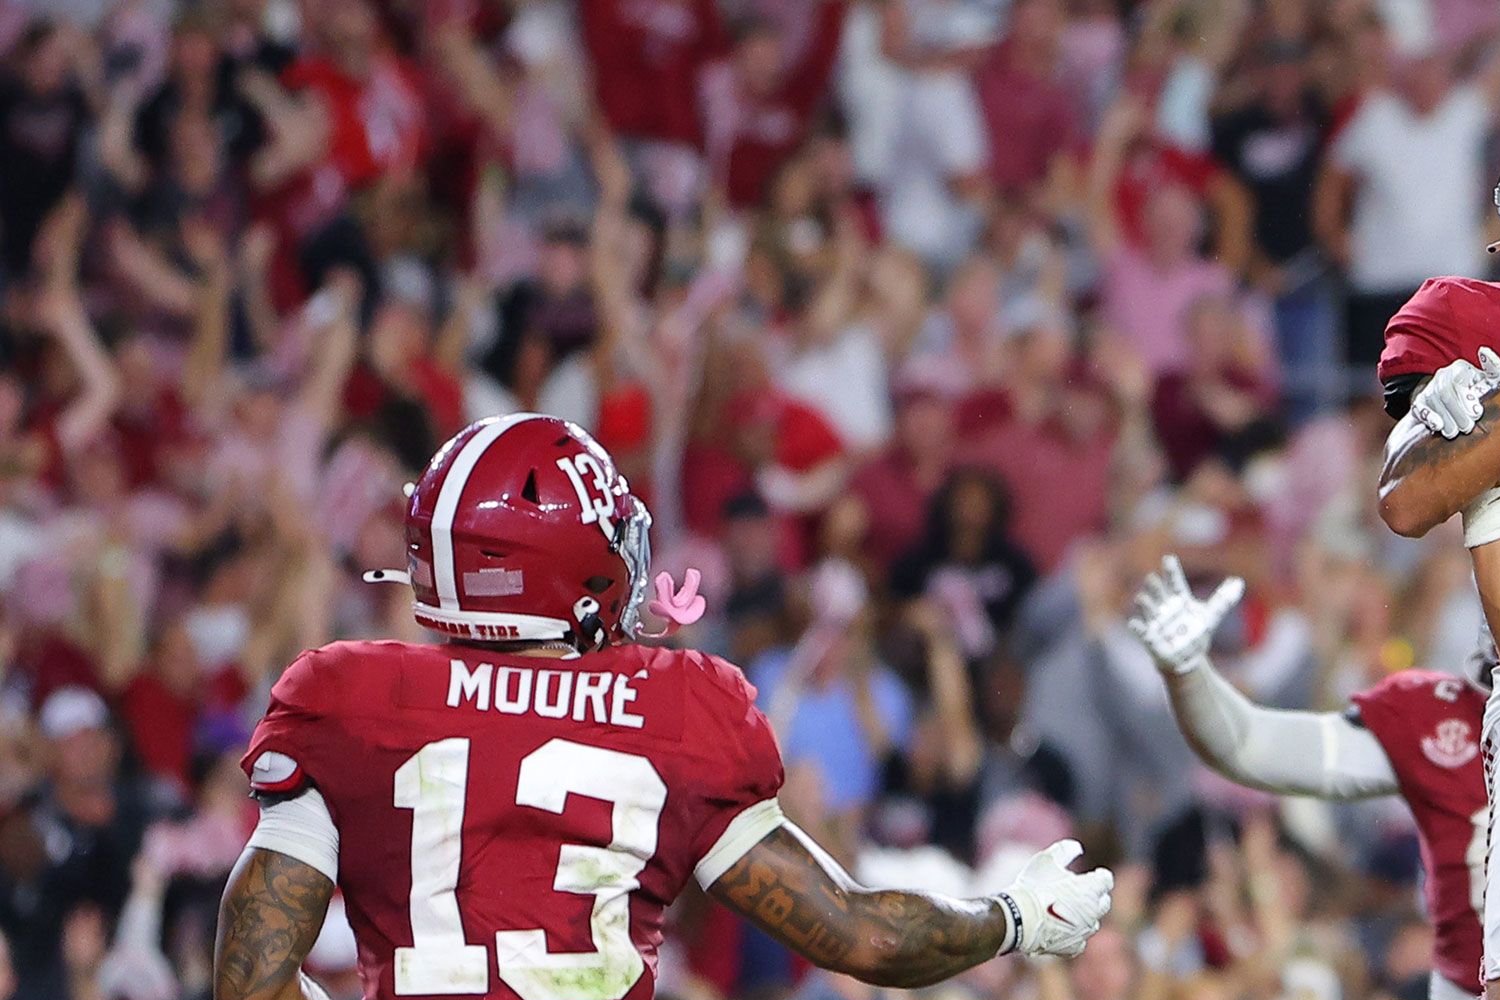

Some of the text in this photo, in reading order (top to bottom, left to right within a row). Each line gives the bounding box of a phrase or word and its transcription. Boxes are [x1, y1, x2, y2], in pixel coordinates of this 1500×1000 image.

[556, 453, 617, 543] 13
[475, 624, 519, 637] TIDE
[446, 659, 649, 729] MOORE
